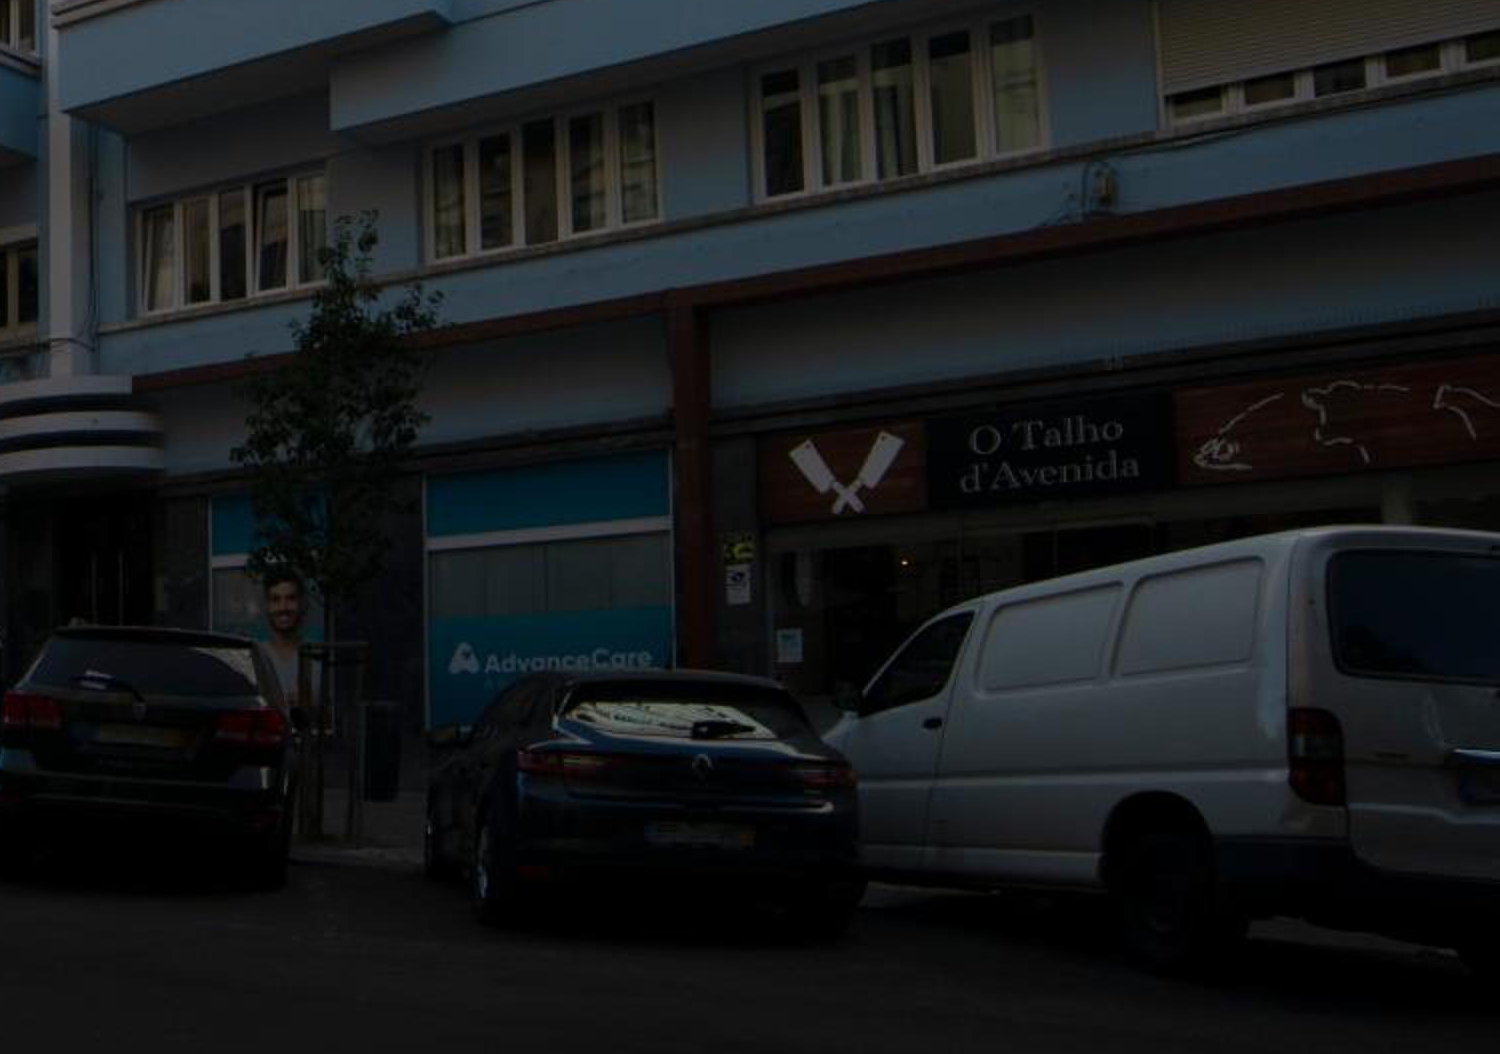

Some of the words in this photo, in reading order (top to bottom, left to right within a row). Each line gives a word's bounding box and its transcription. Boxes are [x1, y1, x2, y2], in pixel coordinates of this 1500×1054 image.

[969, 425, 1002, 455] O
[1011, 415, 1124, 450] Talho
[959, 450, 1141, 493] d'Avenida
[483, 647, 653, 674] AdvanceCare
